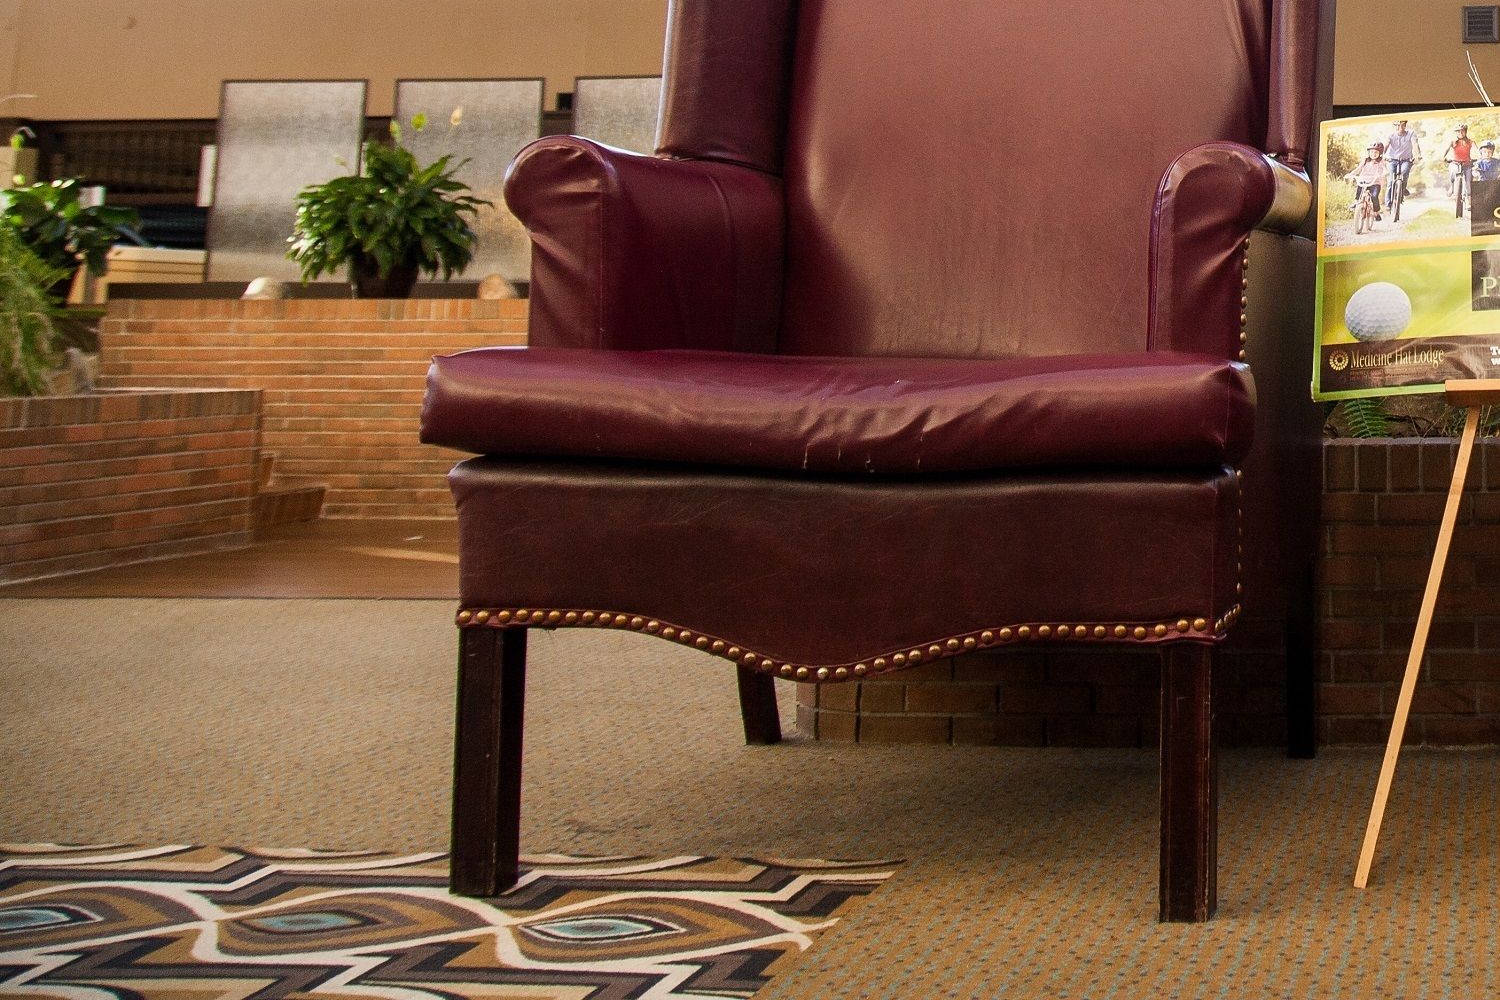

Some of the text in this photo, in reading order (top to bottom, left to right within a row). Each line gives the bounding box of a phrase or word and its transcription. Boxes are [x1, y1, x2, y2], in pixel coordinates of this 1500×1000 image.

[1351, 344, 1445, 369] Medicine Hat Lodge
